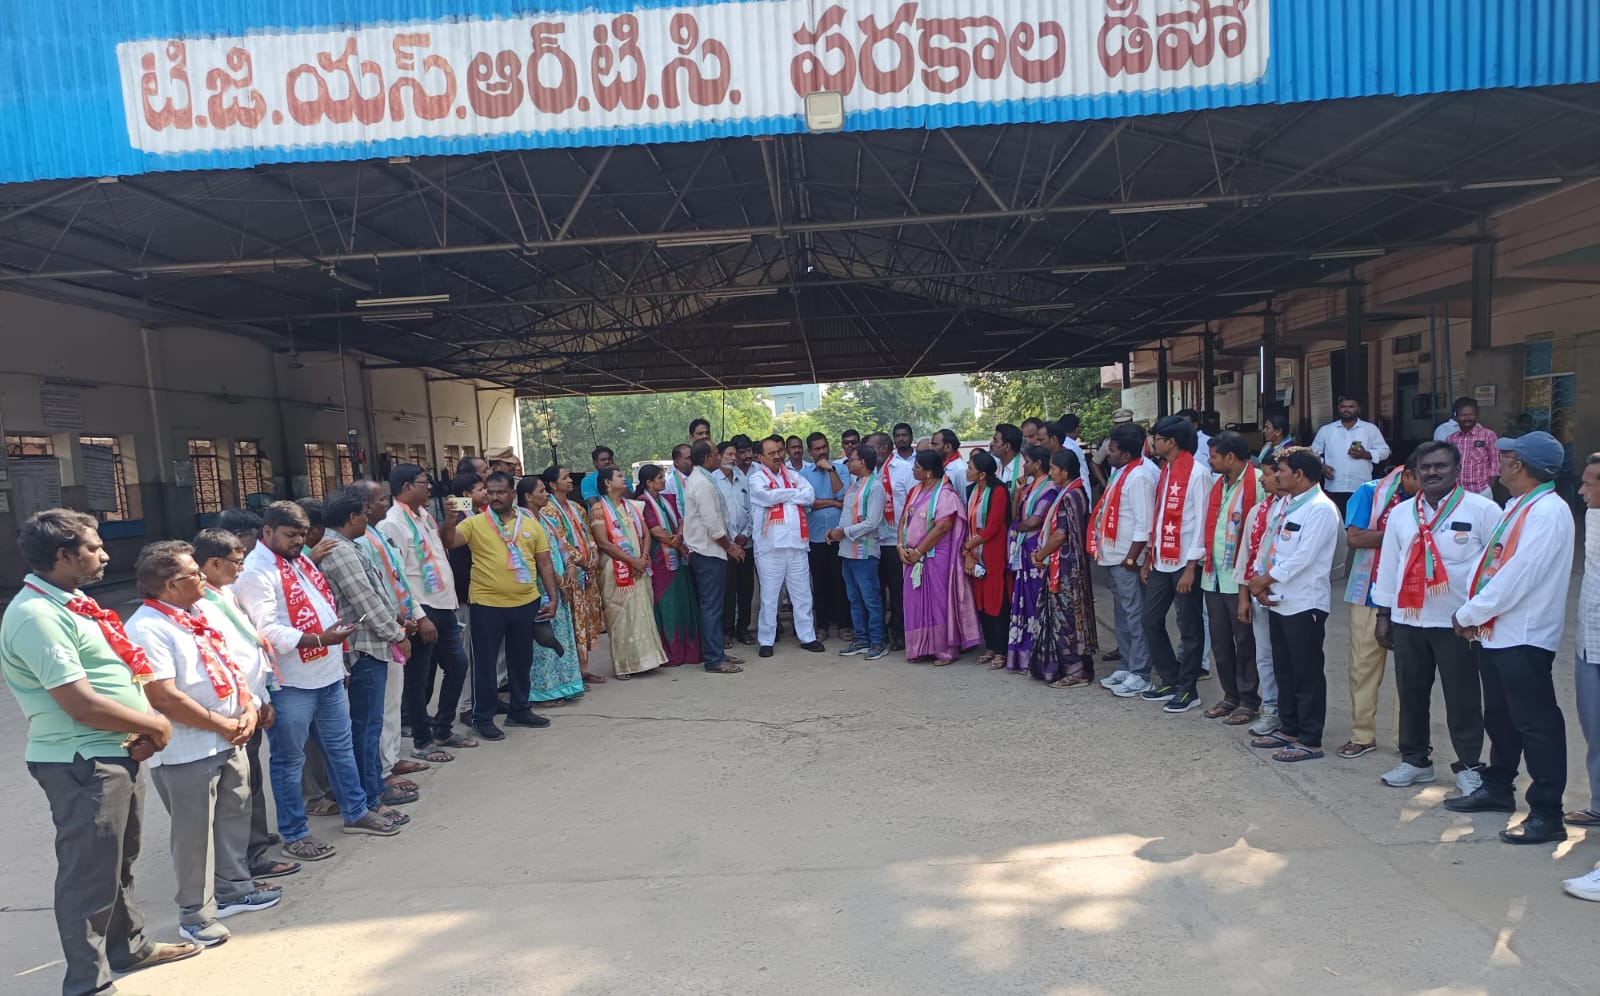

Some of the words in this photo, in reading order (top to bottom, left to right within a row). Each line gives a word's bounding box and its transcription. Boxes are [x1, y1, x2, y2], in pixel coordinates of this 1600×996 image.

[790, 3, 1066, 98] పరకాల
[289, 592, 306, 605] CIT
[296, 617, 318, 632] CITU
